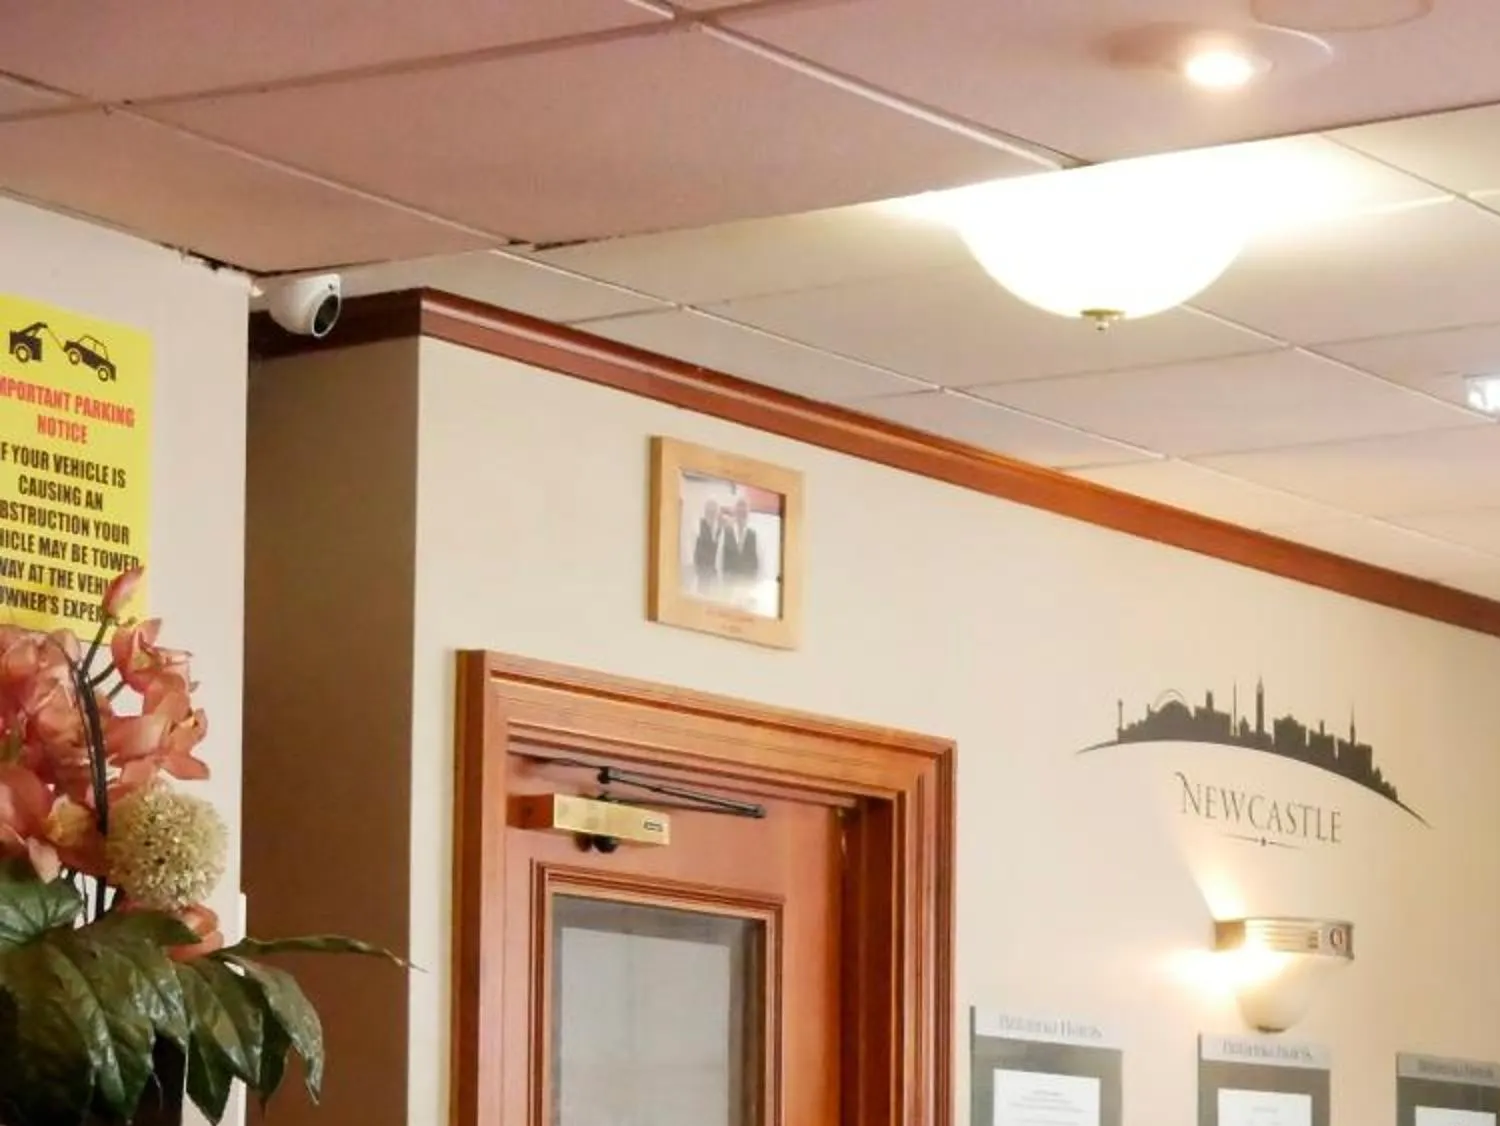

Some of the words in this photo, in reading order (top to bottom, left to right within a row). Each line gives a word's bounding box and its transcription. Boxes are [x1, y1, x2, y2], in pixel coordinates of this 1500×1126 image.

[0, 375, 71, 412] MPORTANT
[75, 394, 135, 428] PARKING
[37, 413, 87, 444] NOTICE
[0, 441, 8, 461] F
[11, 444, 50, 471] YOUR
[53, 453, 109, 485] VEHICLE
[112, 467, 127, 489] IS
[18, 474, 81, 506] CAUSING
[85, 489, 103, 511] AN
[0, 499, 90, 537] BSTRUCTION
[93, 519, 130, 545] YOUR
[0, 527, 35, 554] HICLE
[38, 536, 68, 560] MAY
[71, 543, 89, 565] BE
[0, 556, 25, 579] WAY
[28, 563, 44, 585] AT
[48, 567, 74, 590] THE
[1175, 771, 1342, 844] NEWCASTLE
